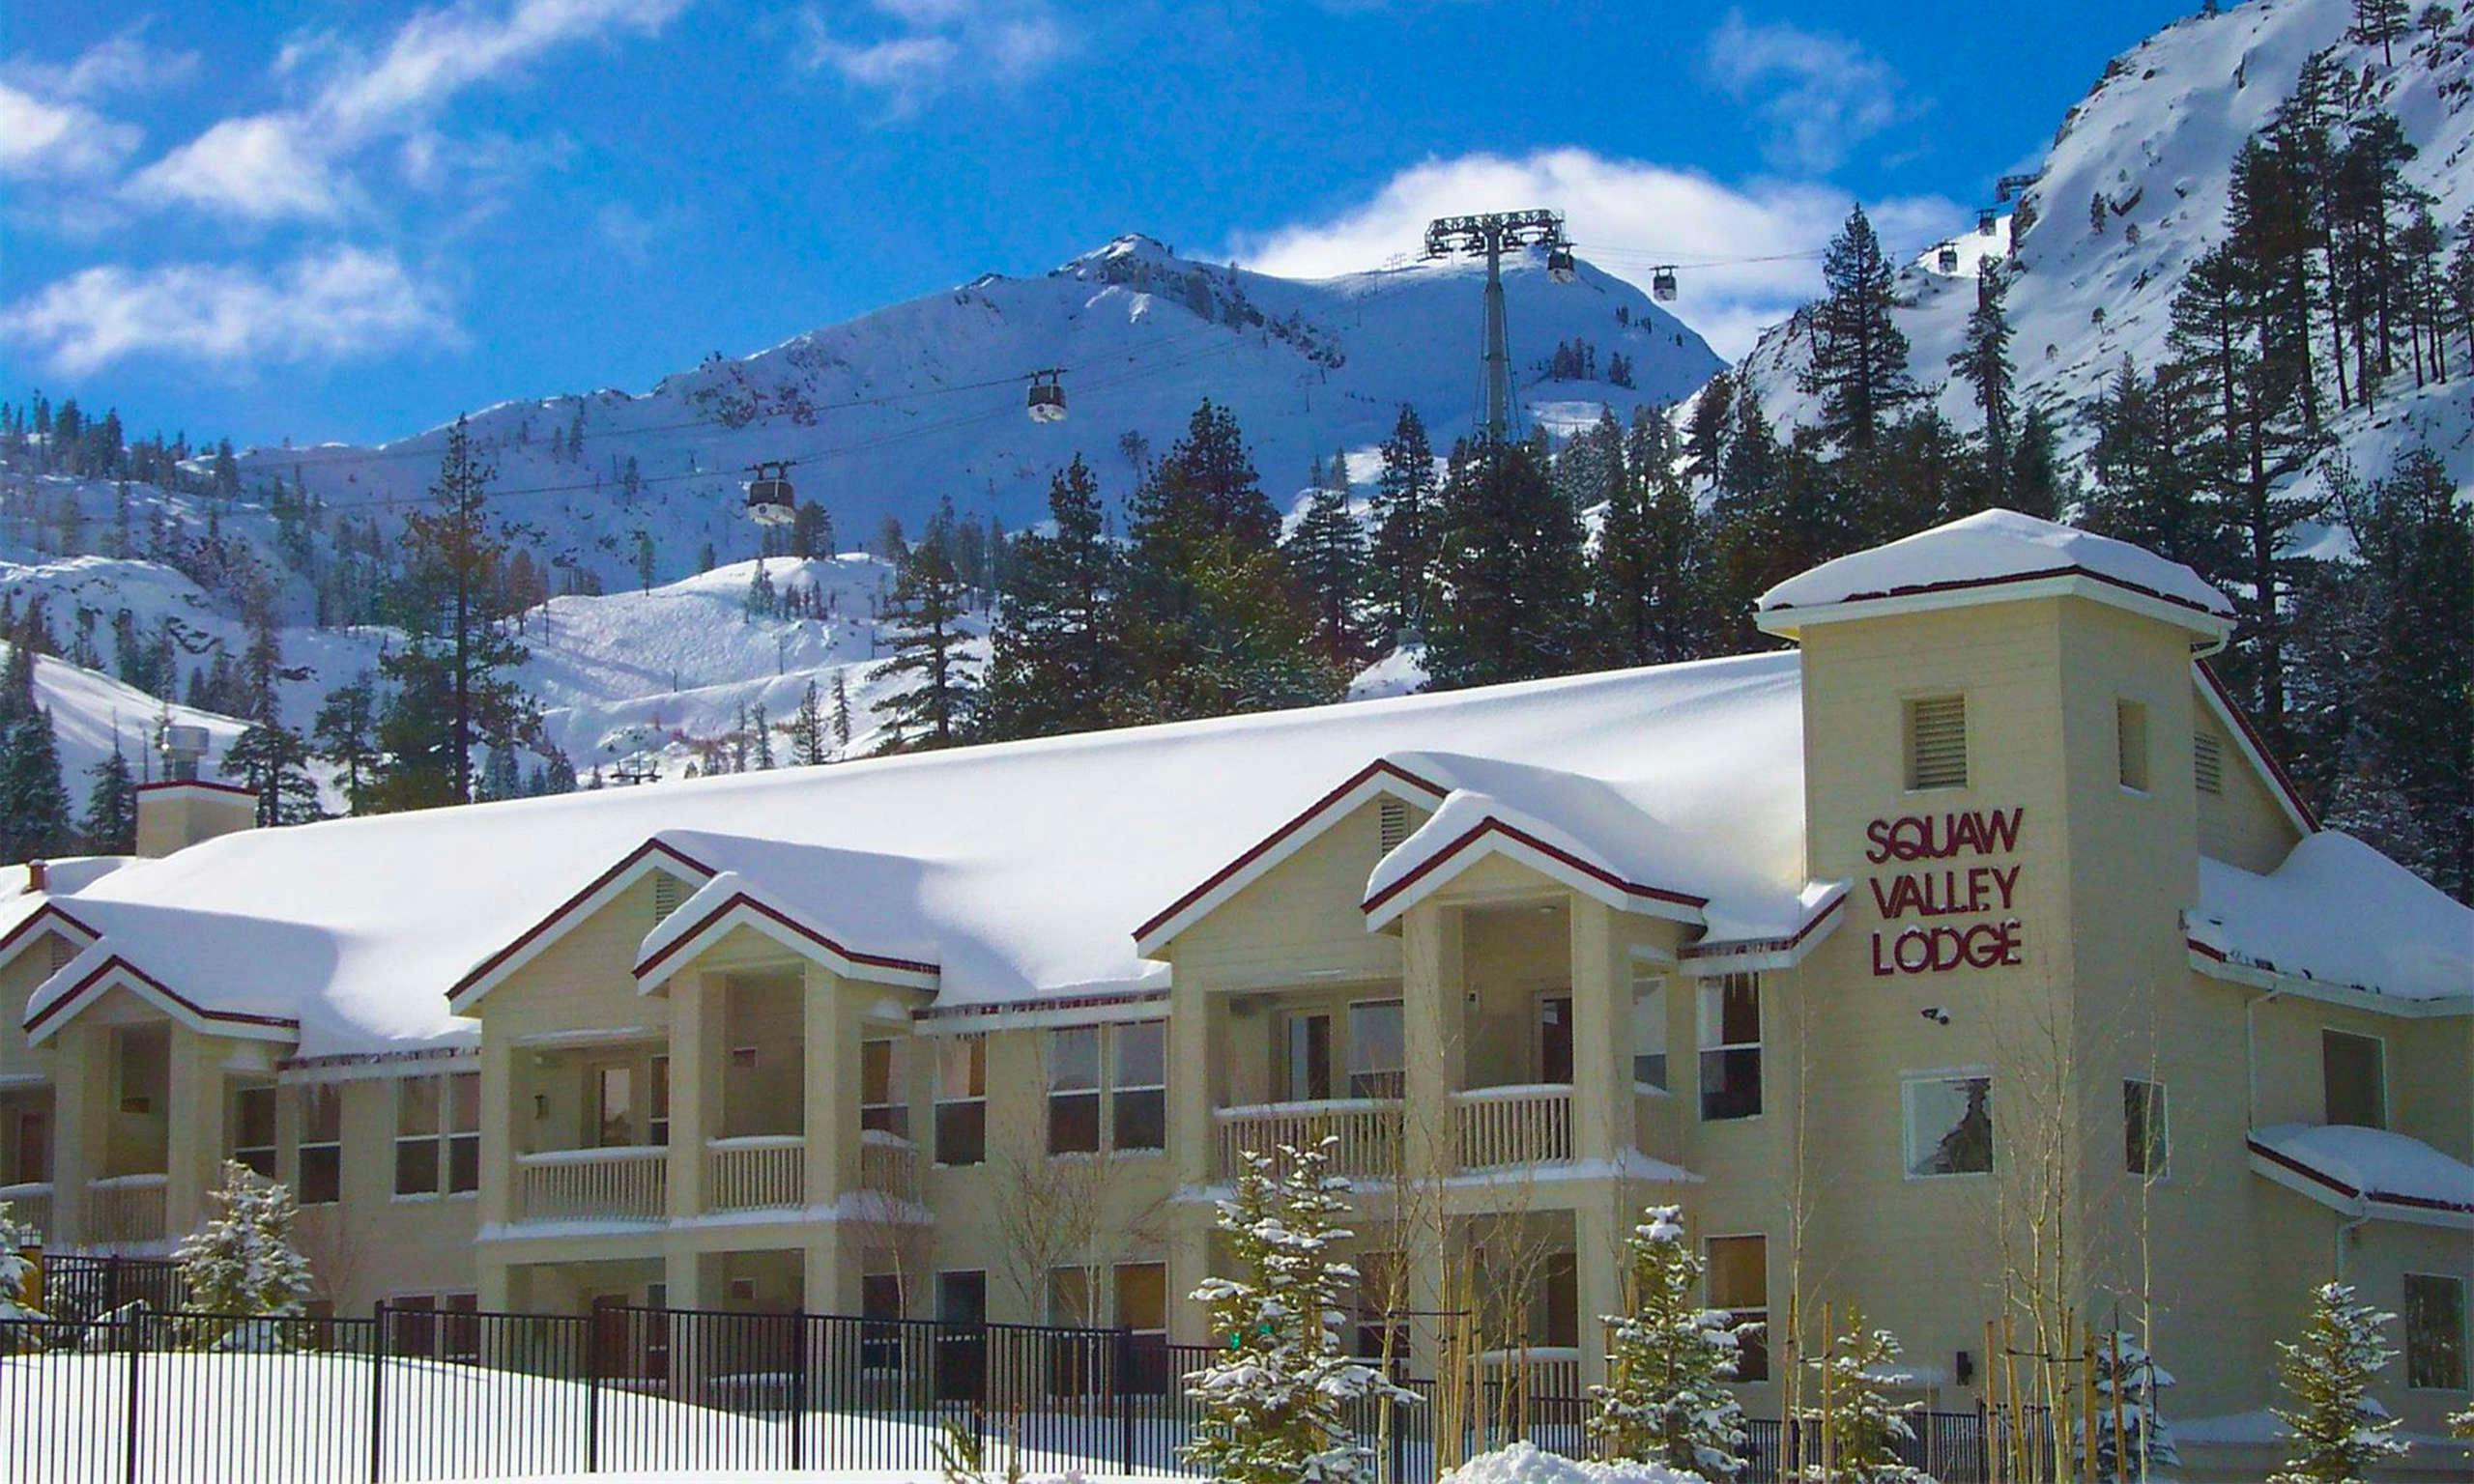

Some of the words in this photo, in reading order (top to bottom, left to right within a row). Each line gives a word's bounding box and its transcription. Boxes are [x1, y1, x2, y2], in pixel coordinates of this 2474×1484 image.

[1866, 808, 2024, 864] SQUAW
[1869, 865, 2021, 919] VALLEY
[1872, 921, 2022, 976] LODGE
